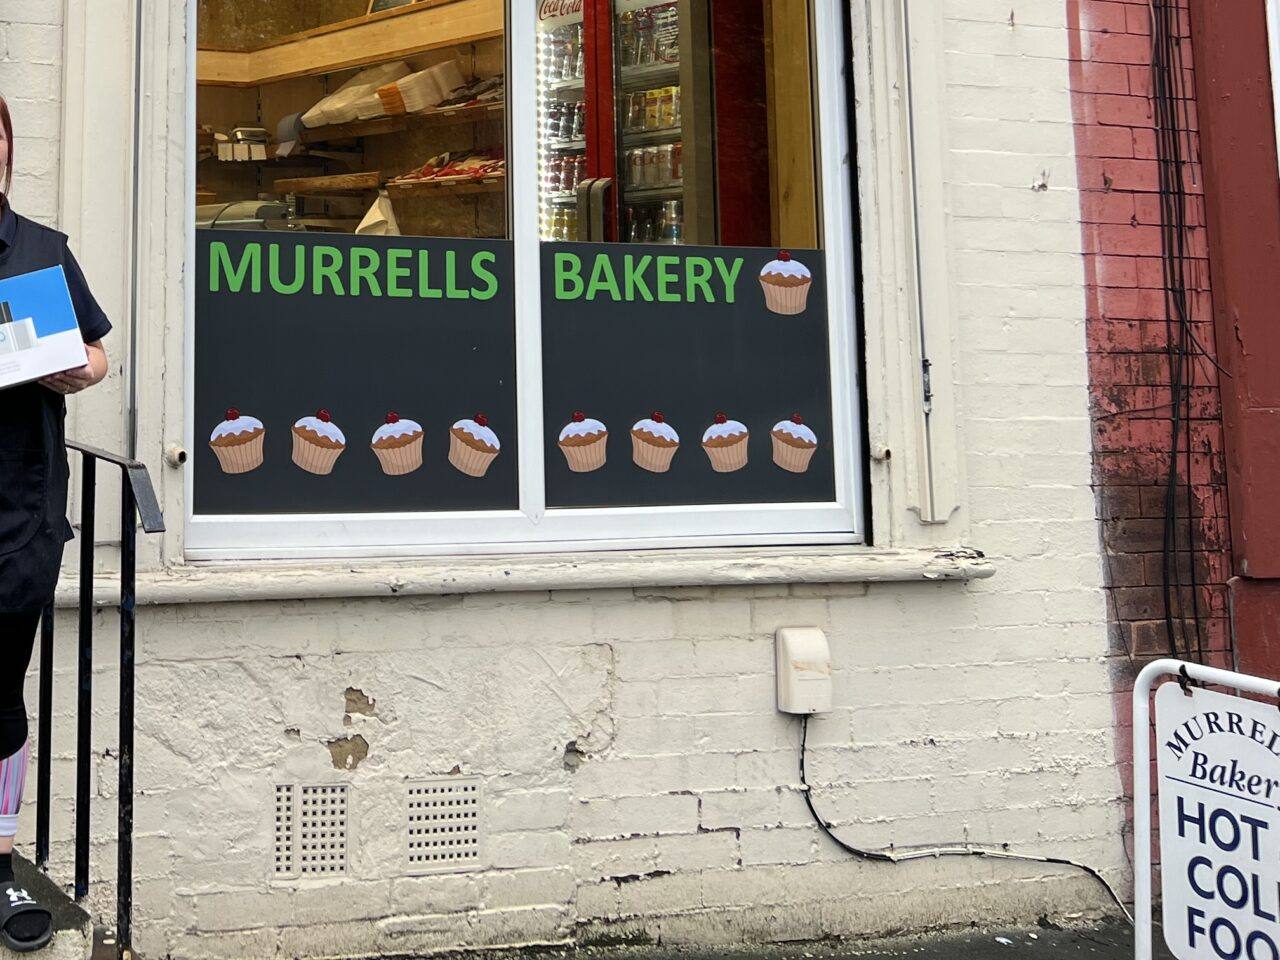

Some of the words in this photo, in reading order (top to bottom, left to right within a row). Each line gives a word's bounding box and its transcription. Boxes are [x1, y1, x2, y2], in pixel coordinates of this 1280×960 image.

[209, 242, 498, 300] MURRELLS
[554, 252, 745, 302] BAKERY
[1176, 795, 1269, 862] HOT
[1187, 855, 1280, 923] COL
